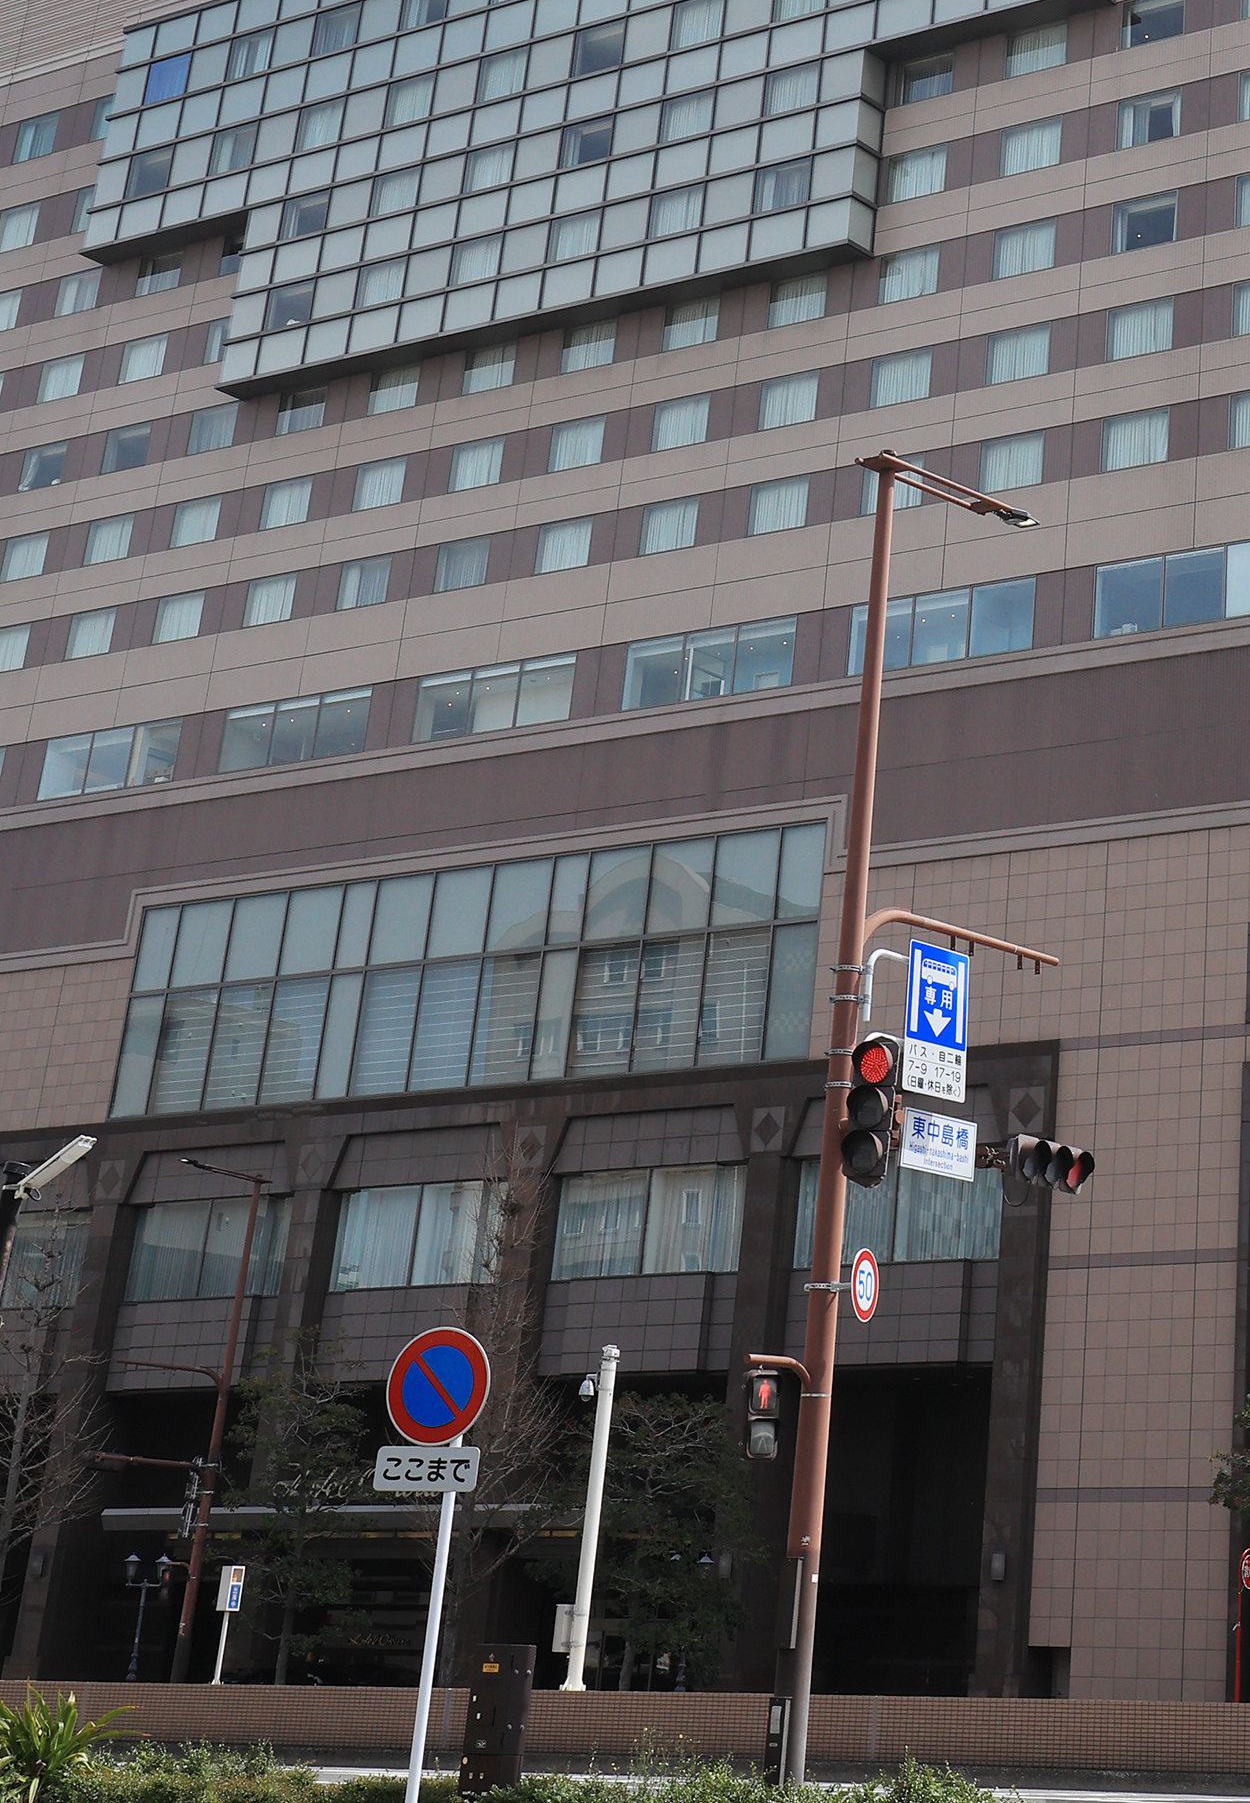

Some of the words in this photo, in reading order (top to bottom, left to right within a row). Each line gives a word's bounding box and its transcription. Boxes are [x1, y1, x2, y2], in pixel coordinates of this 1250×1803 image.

[924, 986, 953, 1011] 専用
[908, 1060, 928, 1075] 7-9
[935, 1067, 961, 1083] 17-19
[911, 1116, 969, 1150] 東中島橋
[858, 1270, 873, 1301] 50
[383, 1457, 470, 1483] ここまで
